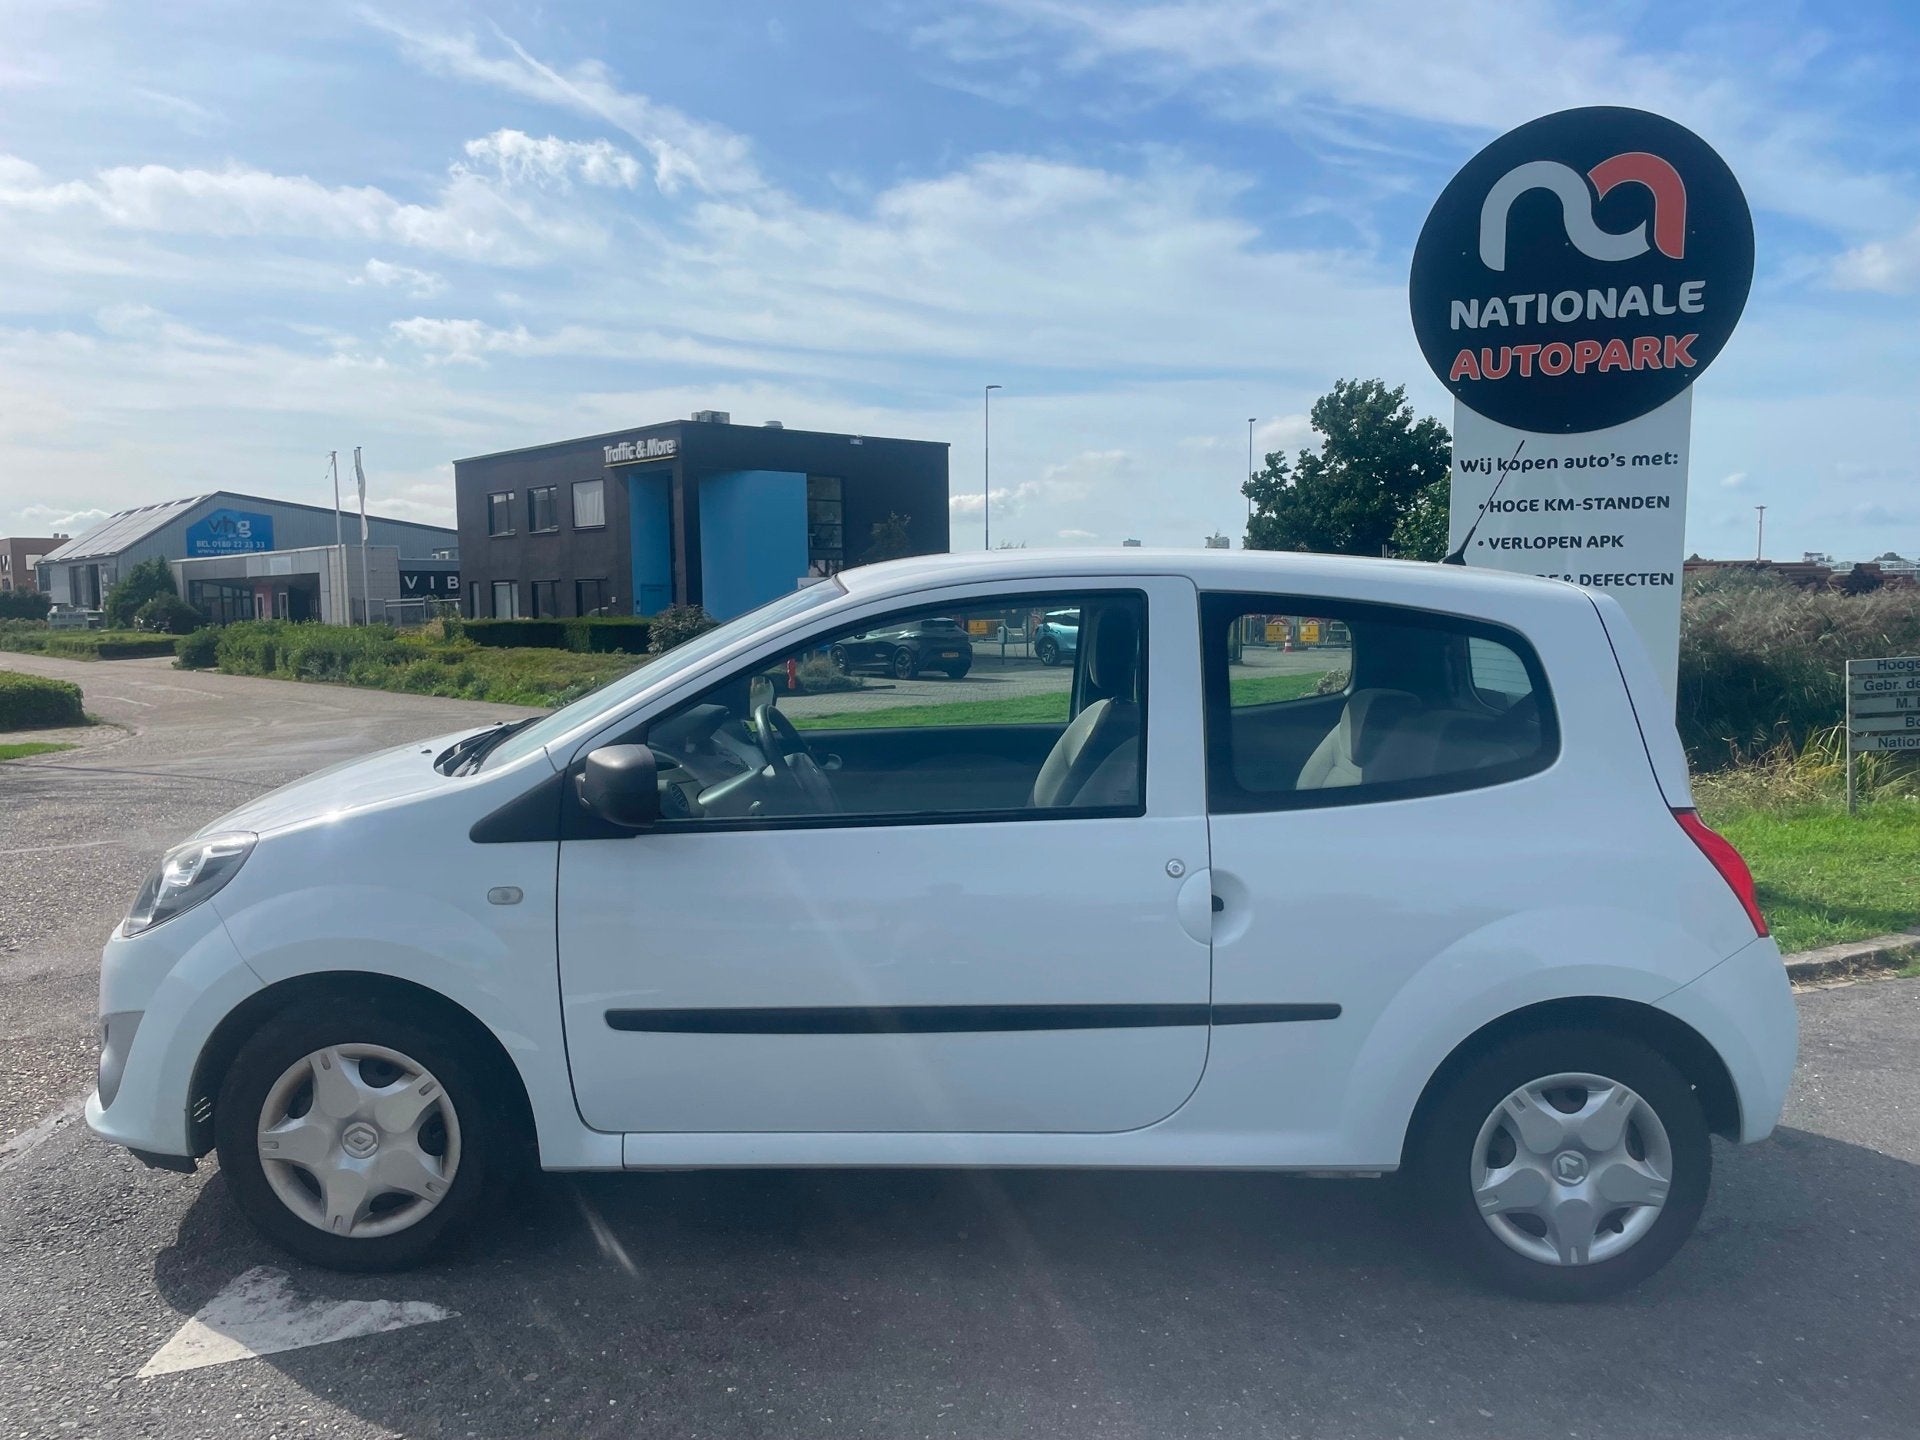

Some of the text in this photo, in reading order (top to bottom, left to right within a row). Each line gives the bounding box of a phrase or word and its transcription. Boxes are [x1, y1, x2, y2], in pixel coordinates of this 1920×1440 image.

[1450, 280, 1706, 330] NATIONALE
[1449, 333, 1700, 383] AUTOPARK
[603, 438, 676, 463] Traffic & More
[1460, 457, 1491, 475] Wij
[1497, 457, 1558, 474] kopen
[1632, 451, 1679, 466] met:
[1489, 495, 1670, 513] HOGE KM-STANDEN
[208, 516, 252, 538] vhg
[1488, 534, 1625, 550] VERLOPEN APK
[1578, 572, 1674, 587] DEFECTEN
[1864, 680, 1901, 691] Gebr.
[1896, 698, 1911, 708] M.
